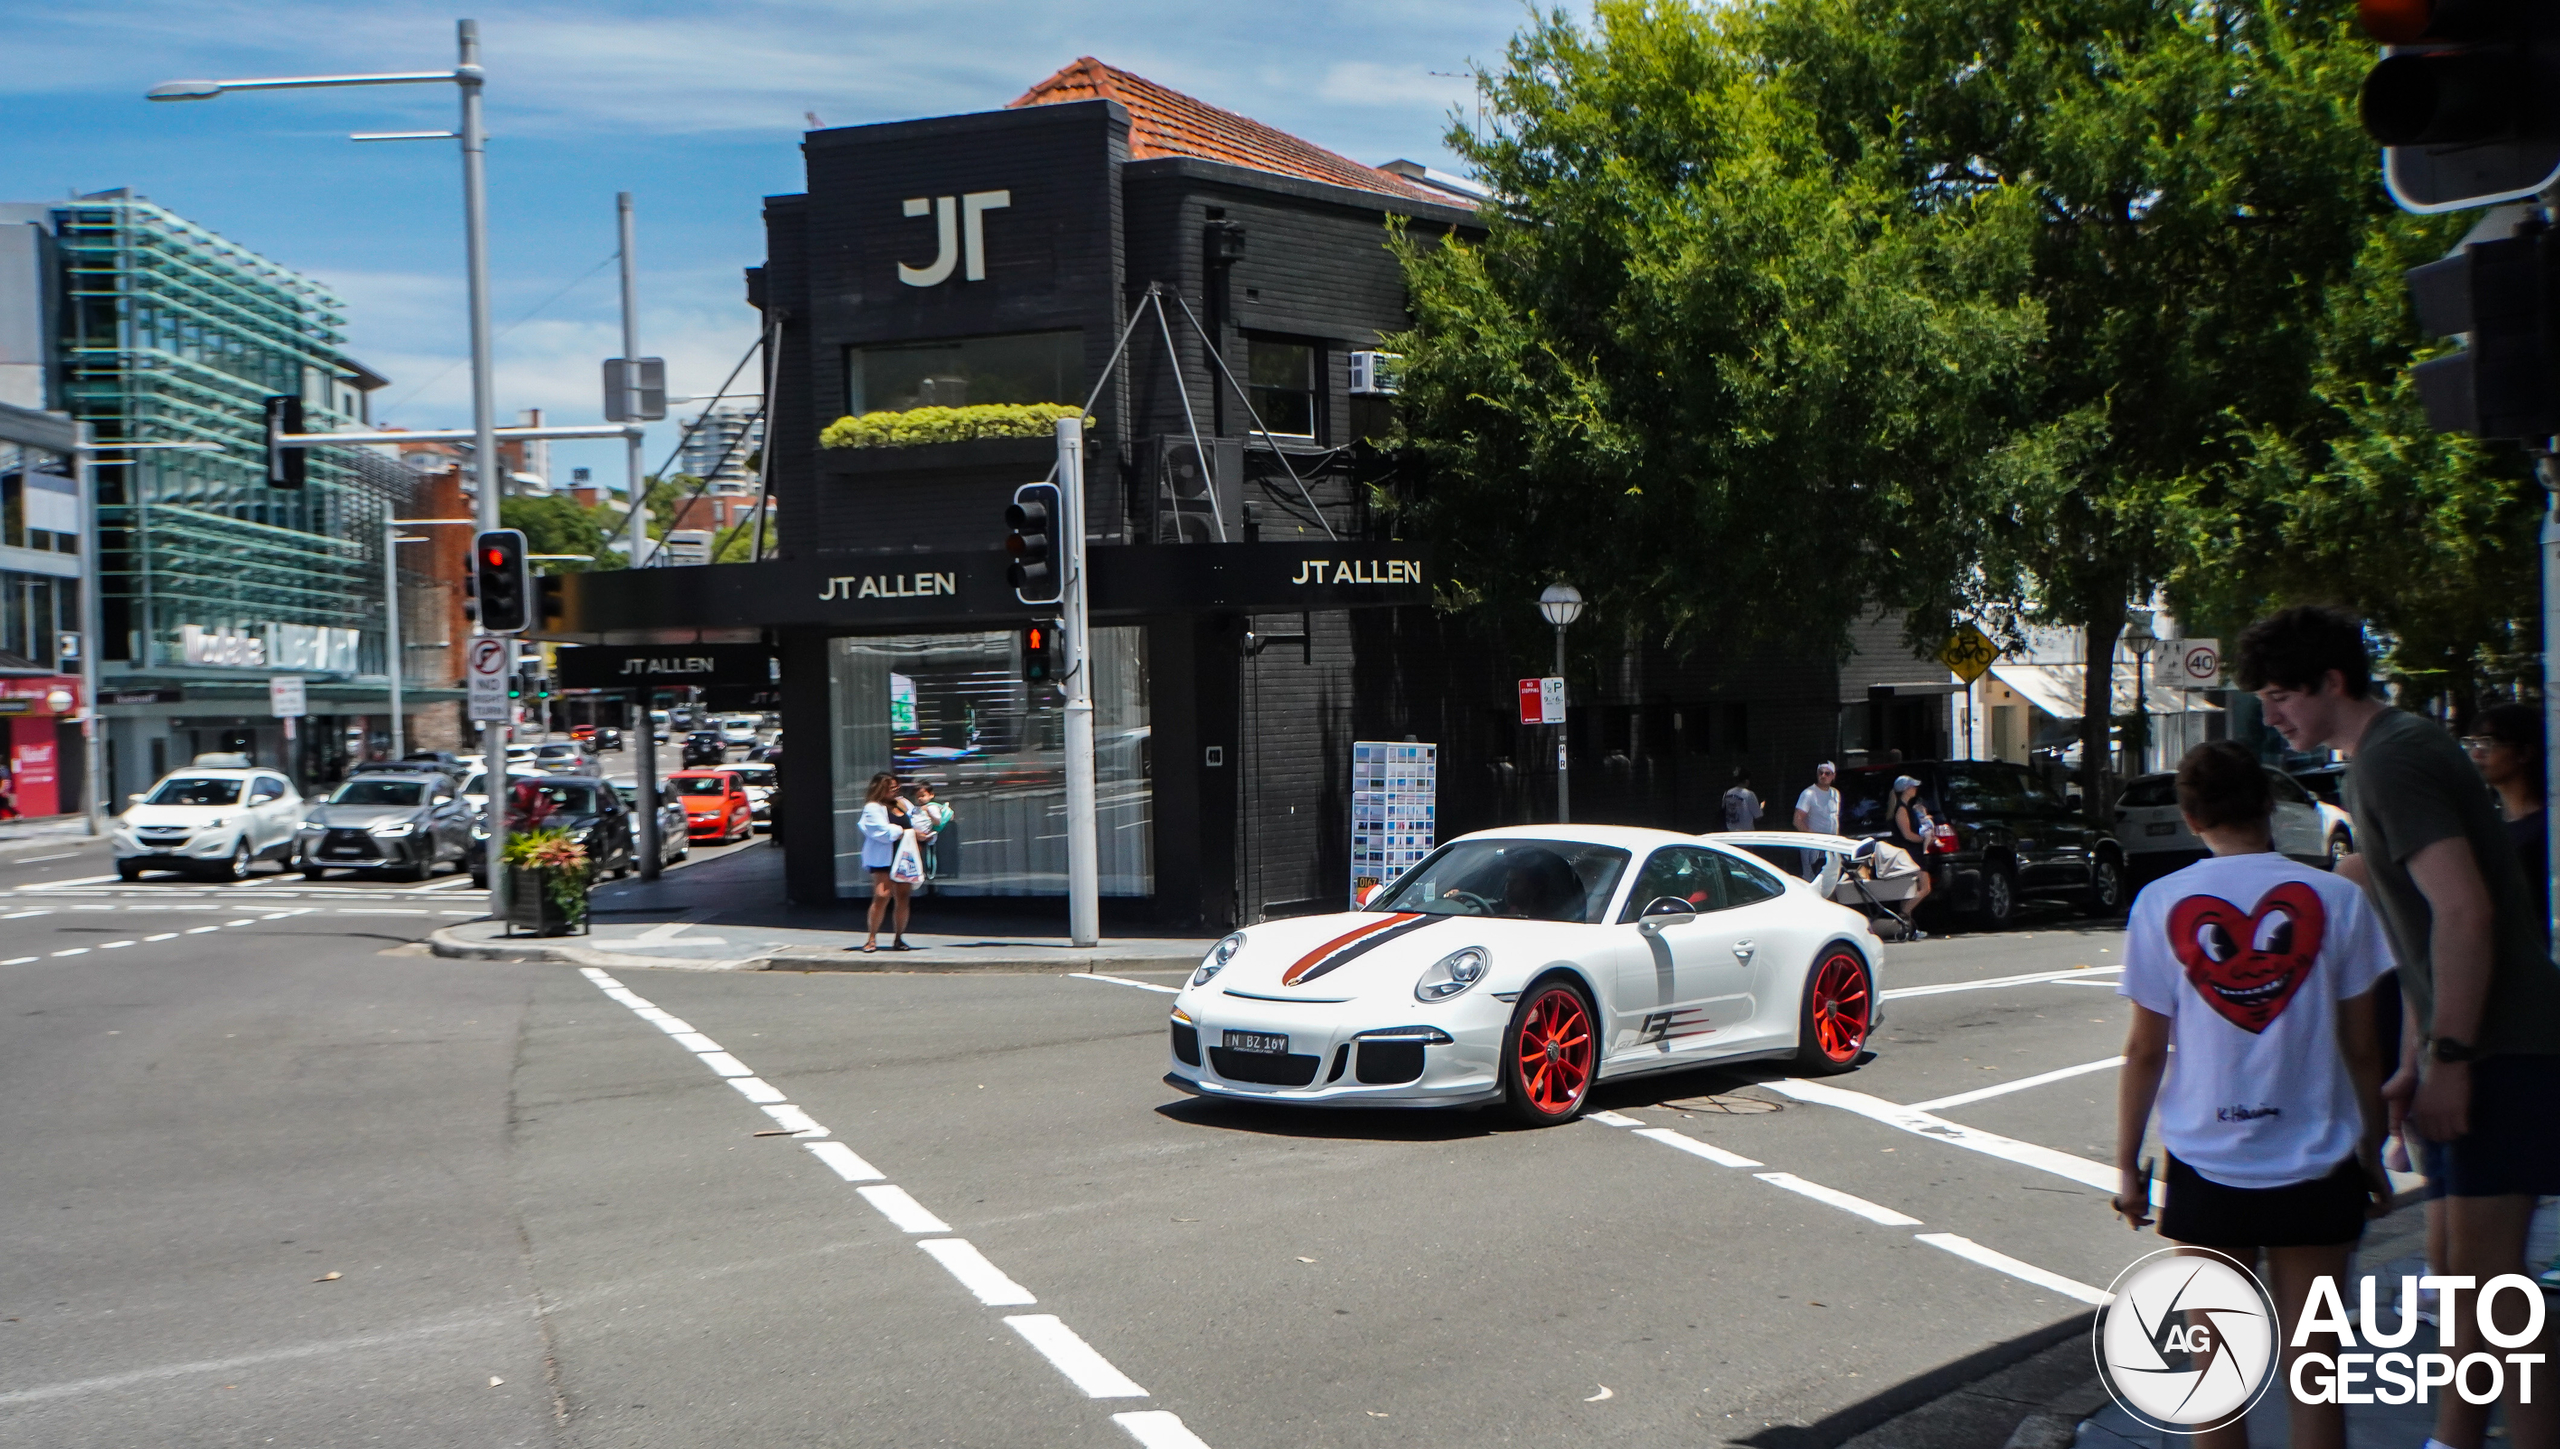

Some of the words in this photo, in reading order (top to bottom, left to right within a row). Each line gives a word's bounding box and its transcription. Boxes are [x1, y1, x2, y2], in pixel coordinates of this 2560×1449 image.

[898, 189, 1011, 287] JT
[1292, 560, 1330, 585] JT
[1332, 560, 1421, 584] ALLEN
[818, 576, 856, 600] JT
[858, 572, 956, 599] ALLEN
[619, 658, 646, 674] JT
[646, 657, 715, 673] ALLEN
[2190, 655, 2213, 670] 40
